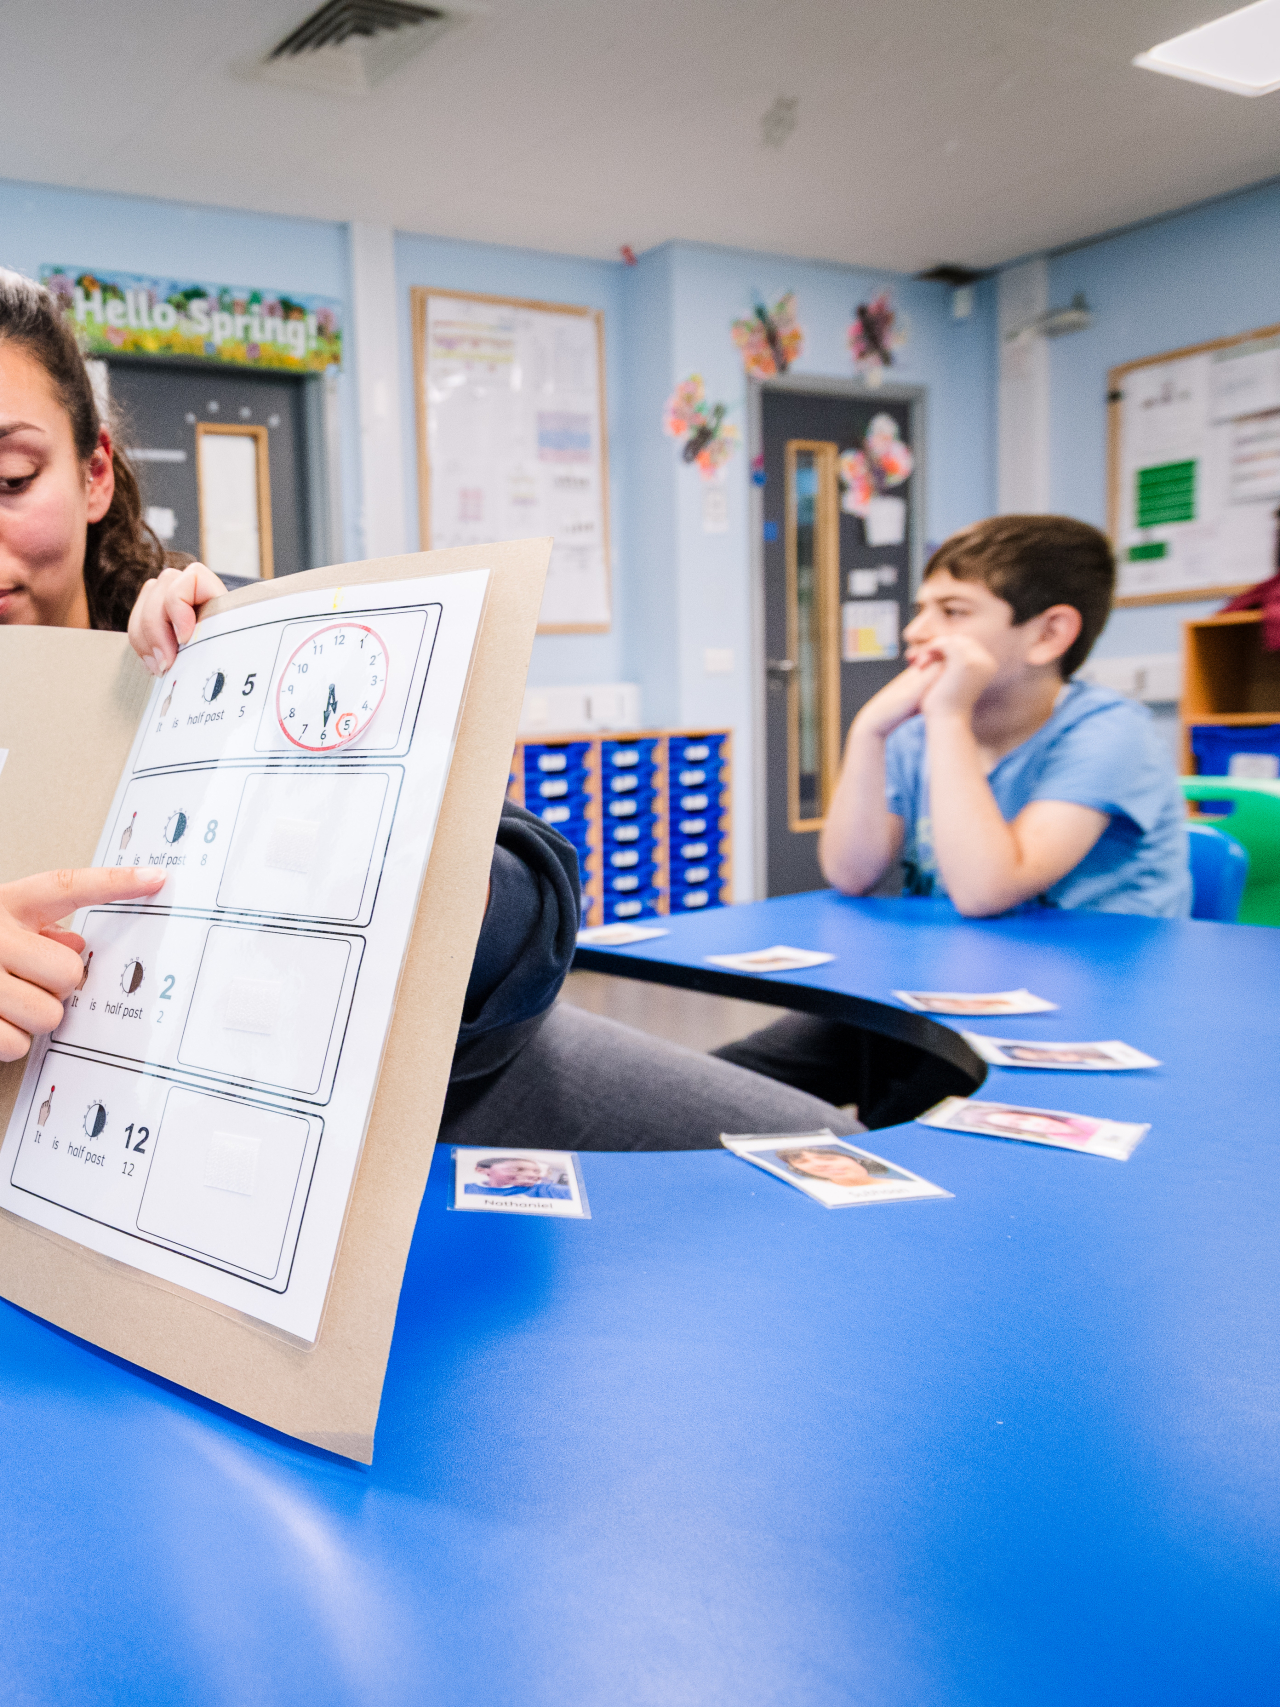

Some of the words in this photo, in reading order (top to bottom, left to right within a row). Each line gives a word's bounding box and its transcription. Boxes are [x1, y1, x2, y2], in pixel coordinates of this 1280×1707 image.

[74, 286, 177, 329] Hello
[188, 299, 318, 357] Spring!
[334, 634, 346, 646] 12
[360, 638, 365, 649] 1
[313, 644, 323, 655] 11
[369, 655, 377, 666] 2
[297, 663, 309, 674] 10
[241, 673, 257, 696] 5
[370, 675, 378, 686] 3
[287, 685, 294, 695] 9
[361, 700, 368, 711] 4
[289, 707, 296, 718] 8
[156, 722, 163, 733] It
[172, 718, 179, 728] is
[186, 711, 206, 726] half
[204, 709, 225, 726] past
[238, 705, 246, 718] 5
[343, 719, 351, 731] 5
[302, 723, 309, 735] 7
[320, 729, 327, 740] 6
[203, 819, 219, 844] 8
[115, 854, 123, 866] It
[133, 853, 140, 866] is
[148, 853, 167, 865] half
[165, 855, 187, 868] past
[200, 853, 208, 866] 8
[159, 974, 176, 1000] 2
[71, 995, 79, 1008] It
[89, 998, 97, 1011] is
[104, 1000, 124, 1015] half
[121, 1006, 143, 1020] past
[156, 1010, 164, 1024] 2
[124, 1123, 150, 1155] 12
[34, 1130, 42, 1144] It
[52, 1136, 59, 1150] is
[67, 1141, 87, 1159] half
[84, 1154, 106, 1167] past
[121, 1161, 135, 1177] 12
[484, 1199, 553, 1209] Nathaniel
